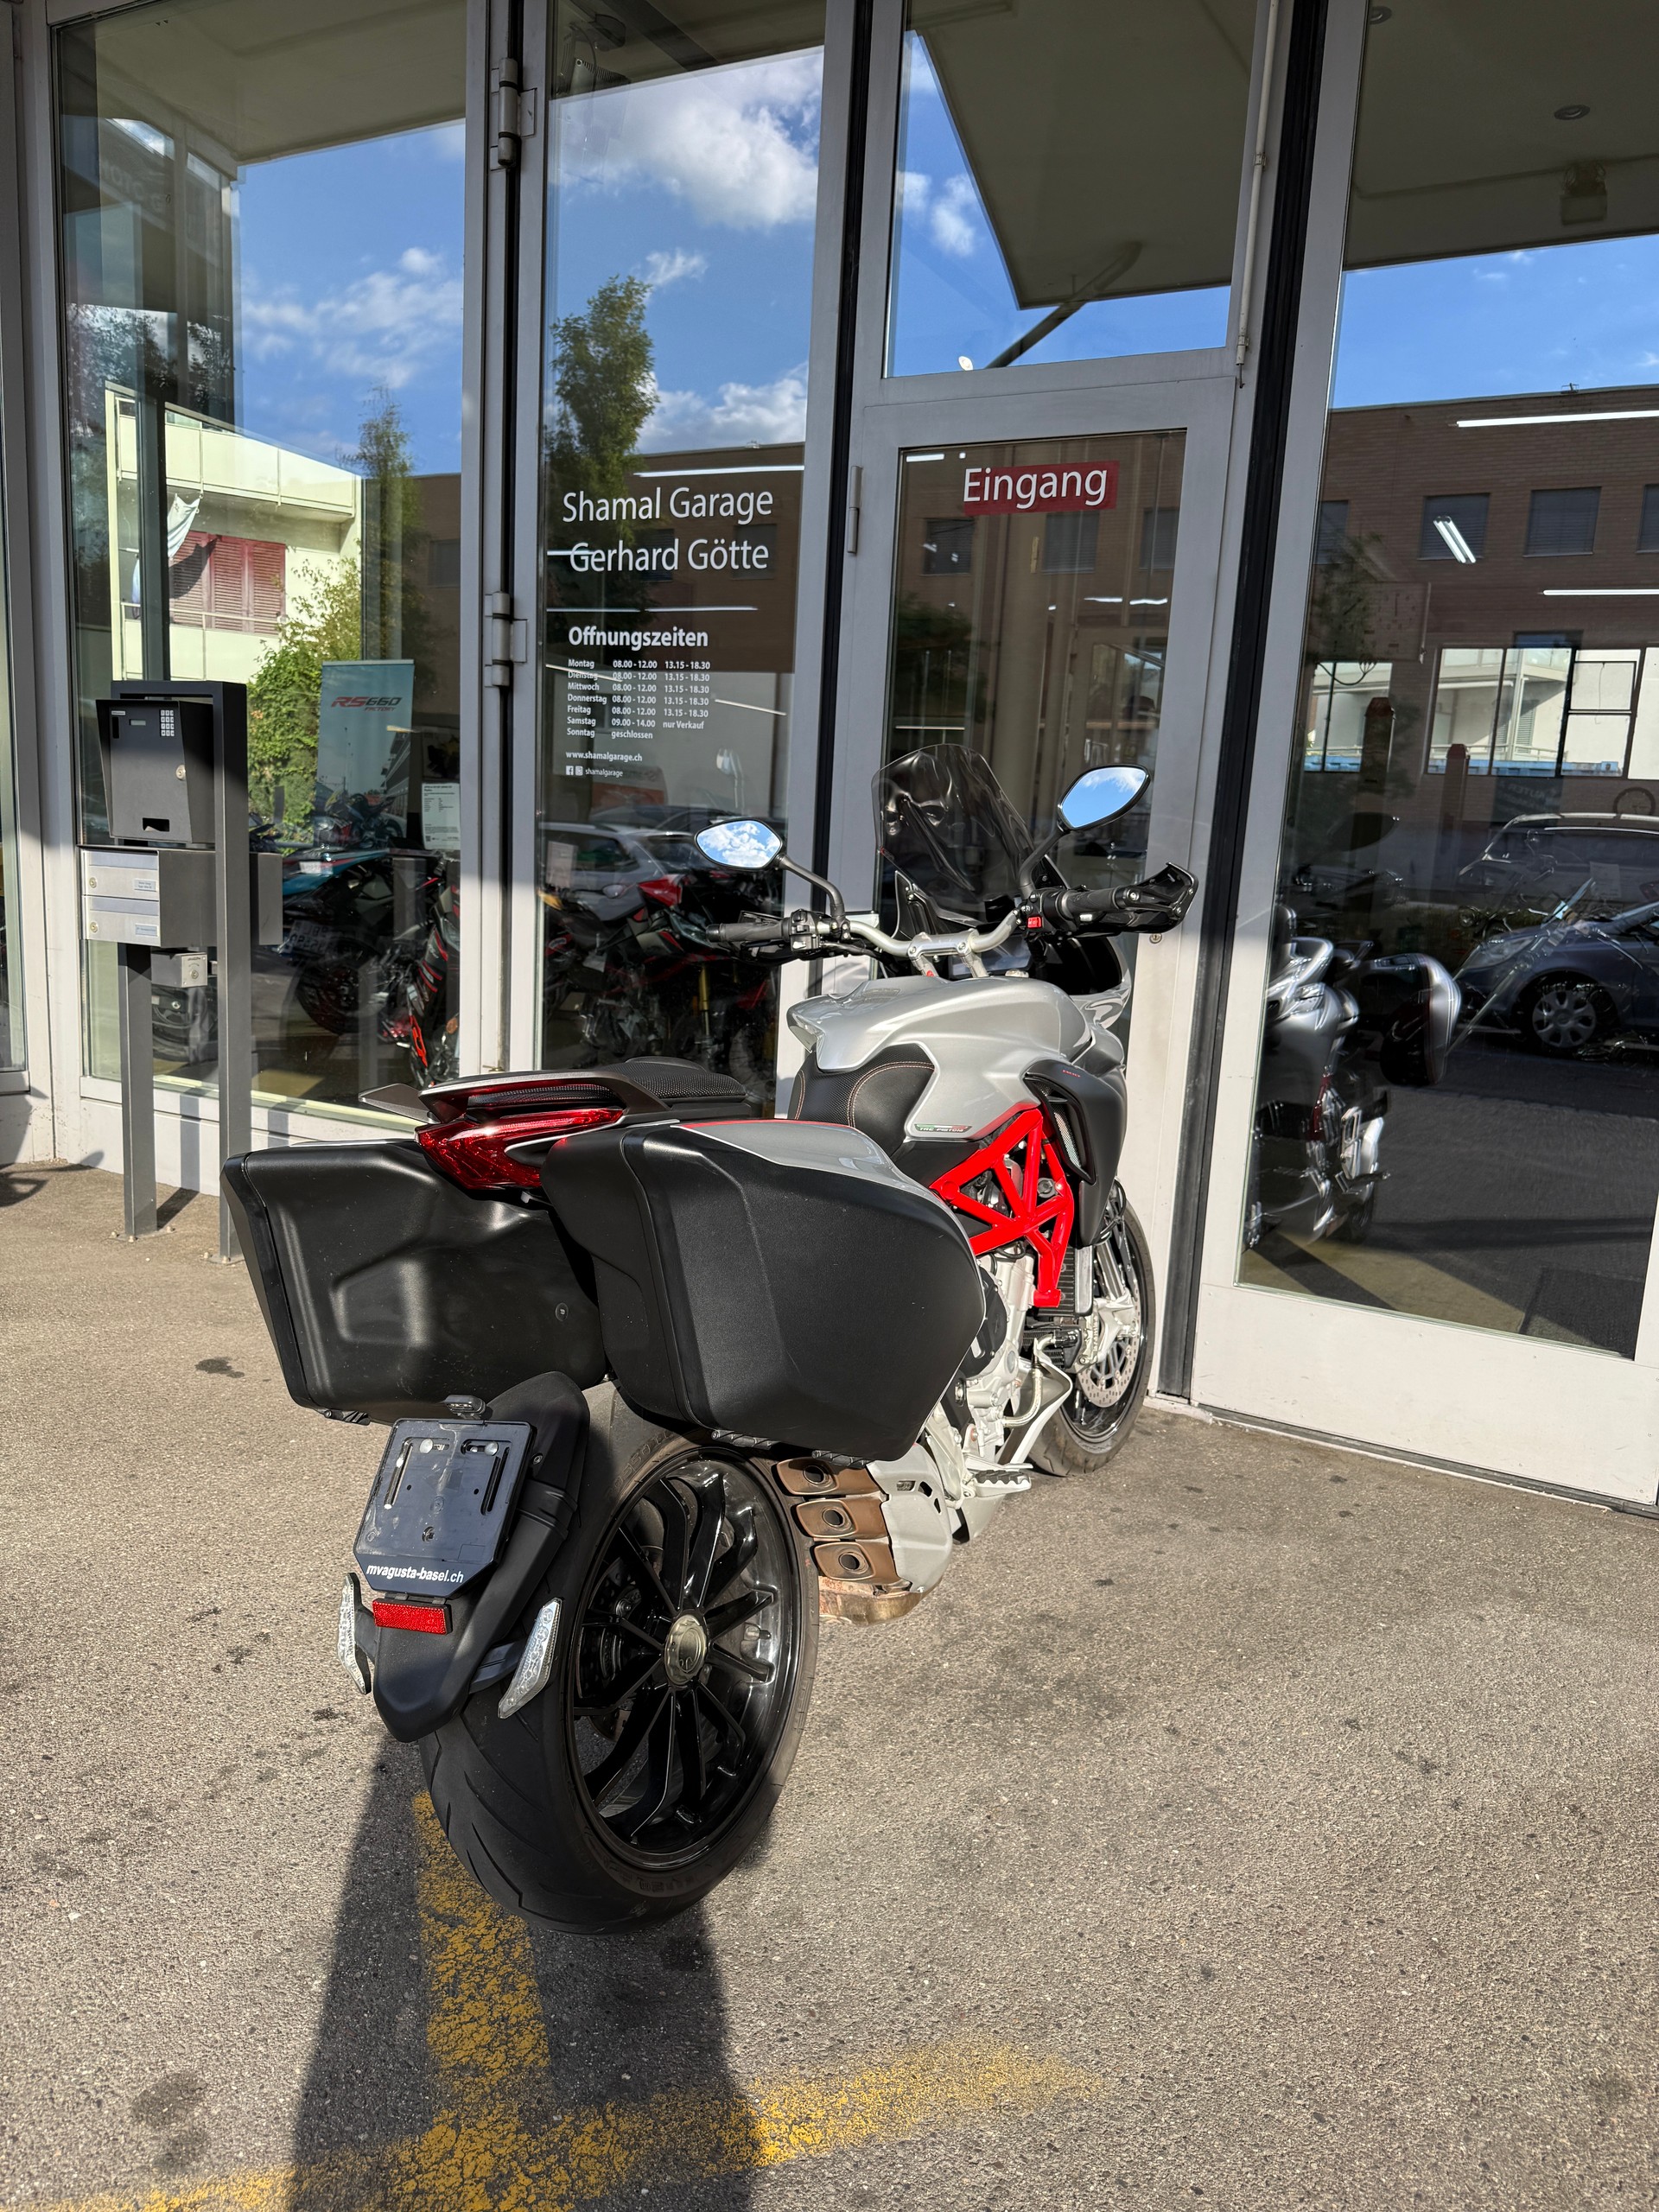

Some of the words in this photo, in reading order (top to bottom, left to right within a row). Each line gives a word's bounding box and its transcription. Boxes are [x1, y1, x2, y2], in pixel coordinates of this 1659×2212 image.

[963, 467, 1108, 510] Eingang
[563, 486, 661, 523] Shamal
[670, 486, 773, 525] Garage
[569, 538, 679, 572] Gerhard
[687, 538, 769, 570] Götte
[568, 659, 594, 669] Montag
[638, 660, 658, 669] 12.00
[664, 661, 684, 670] 13.15
[690, 661, 710, 670] 18.30
[568, 671, 598, 681] Dienstag
[690, 673, 709, 682] 18.30
[568, 683, 600, 691] Mittwoch
[690, 685, 709, 694] 18.30
[567, 694, 607, 704] Donnerstag
[637, 696, 657, 704] 12.00
[690, 697, 709, 706] 18.30
[567, 705, 591, 715] Freitag
[689, 709, 709, 718] 18.30
[567, 716, 596, 727] Samstag
[636, 719, 656, 728] 14.00
[676, 721, 704, 729] Verkauf
[567, 728, 595, 738] Sonntag
[611, 730, 653, 739] geschlossen
[565, 750, 643, 762] www.shamalgarage.ch
[585, 767, 623, 778] shamalgarage
[366, 1565, 464, 1583] mvagusta-basel.ch
